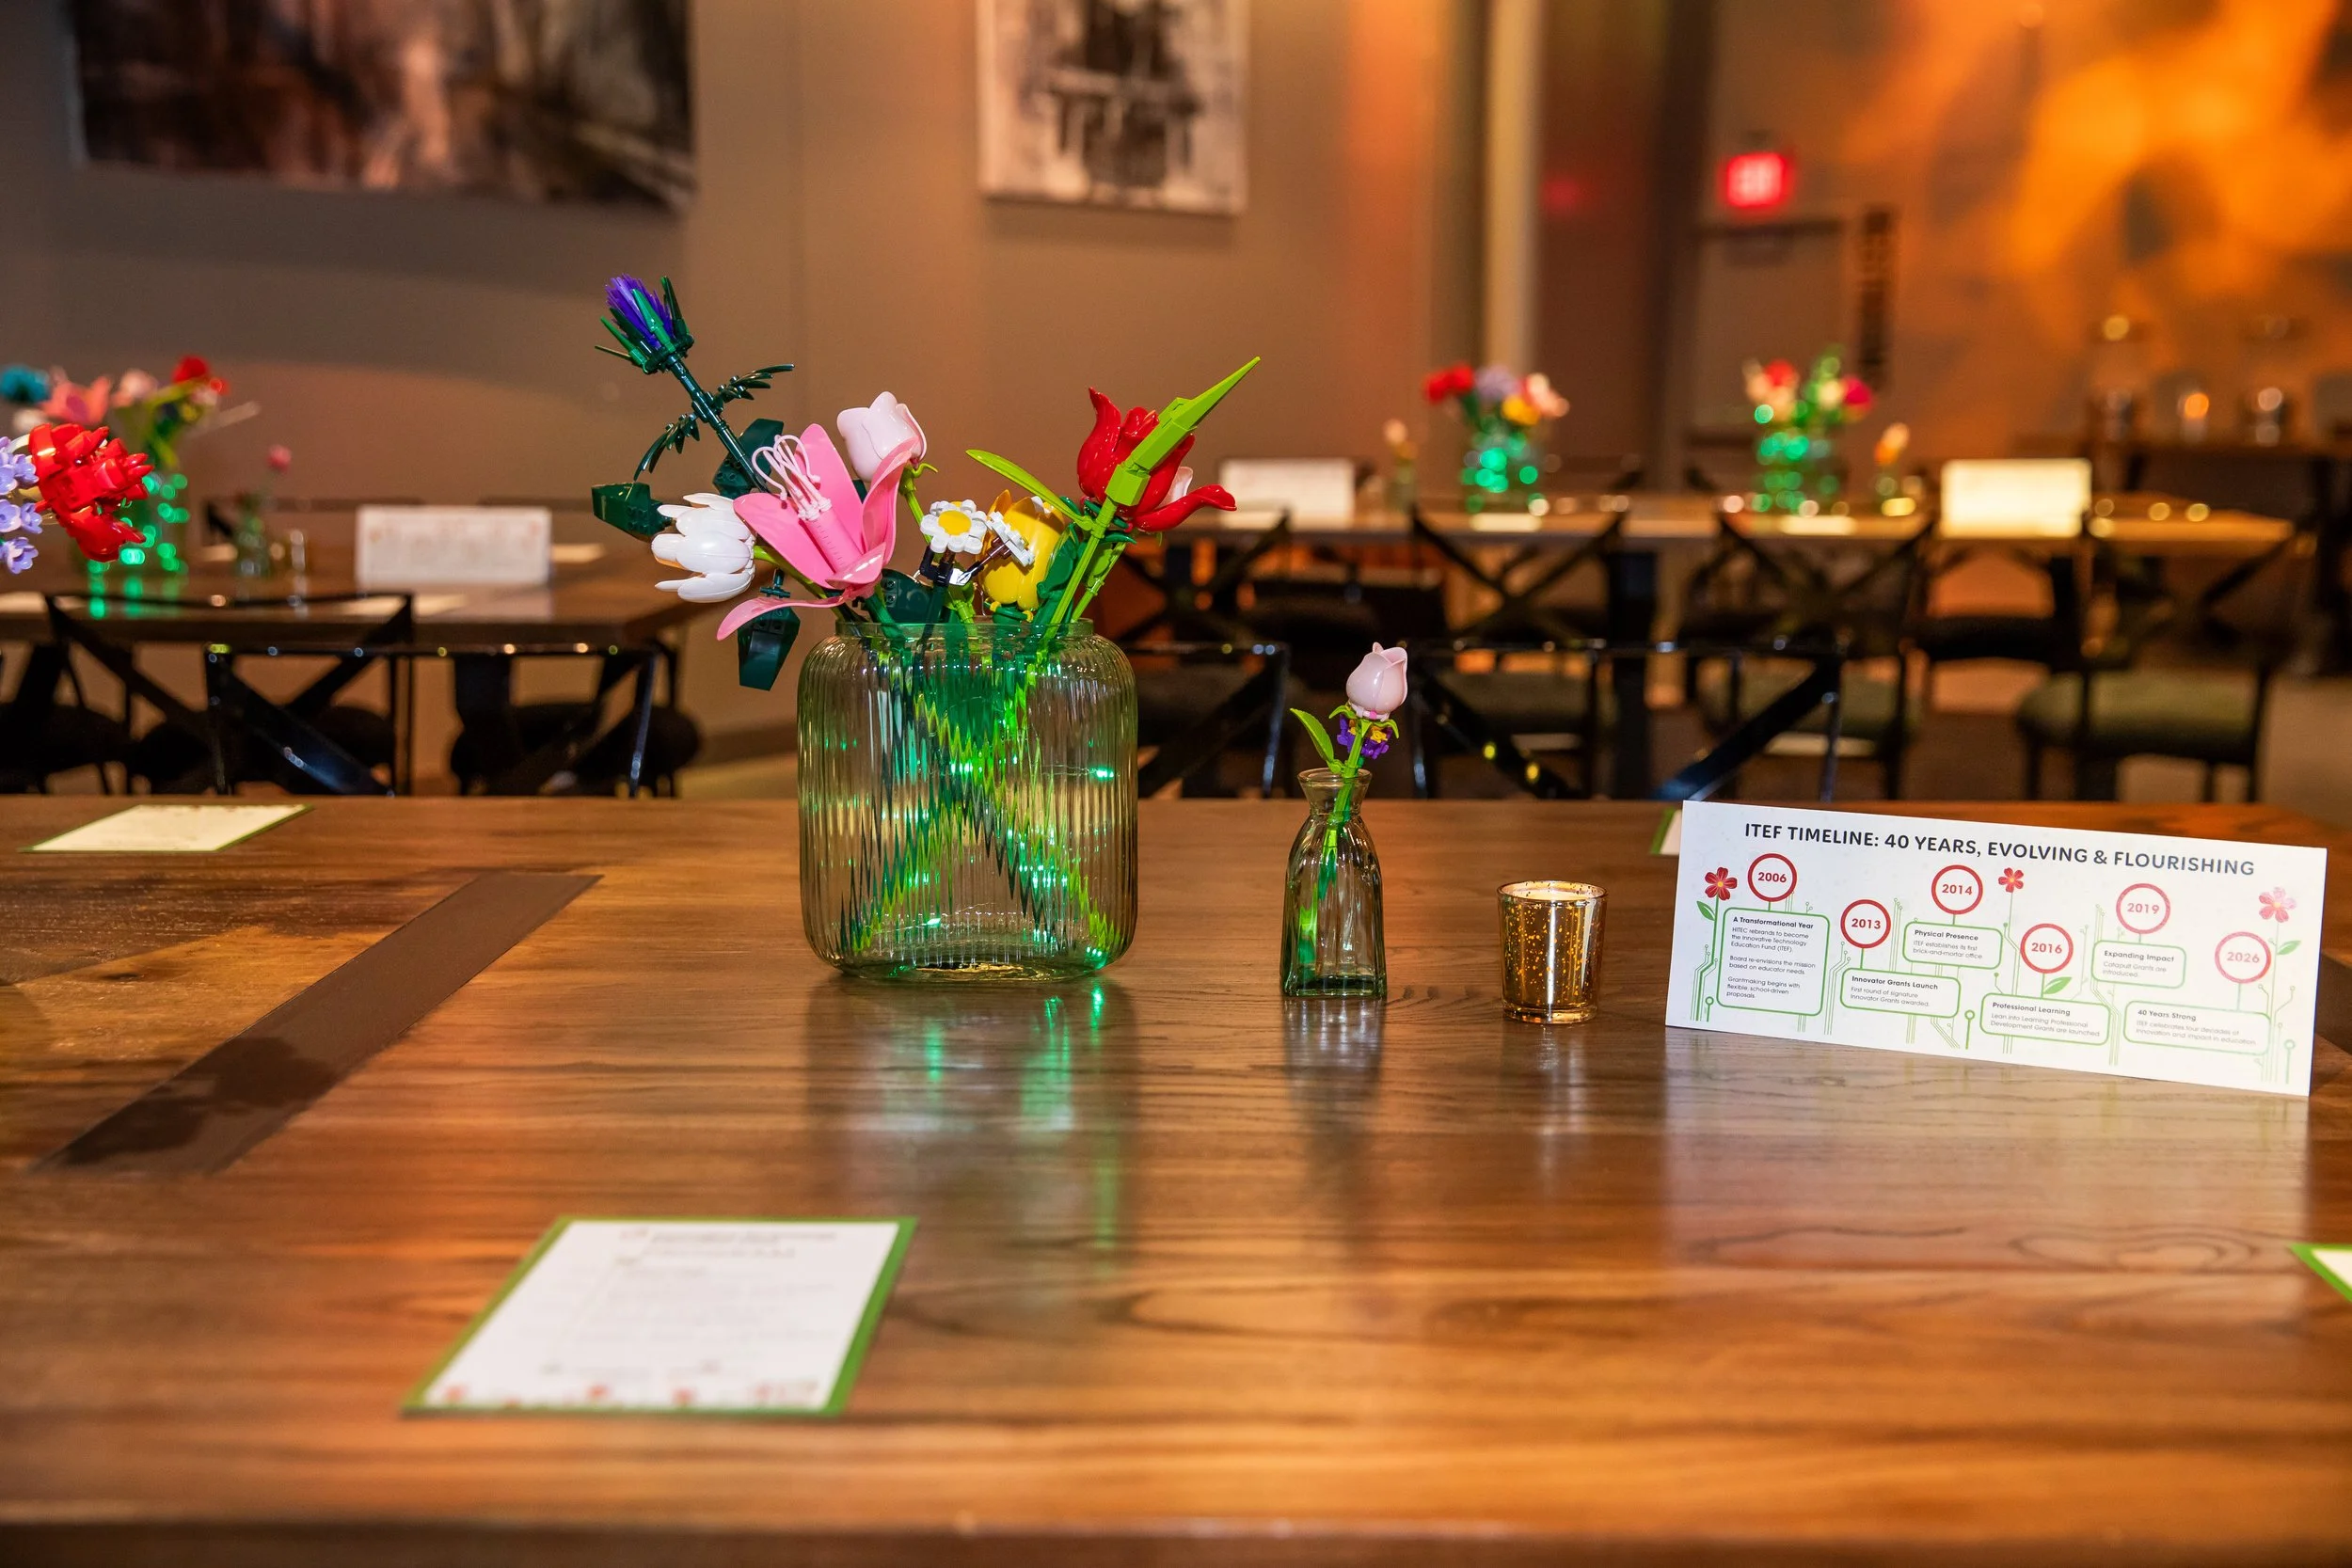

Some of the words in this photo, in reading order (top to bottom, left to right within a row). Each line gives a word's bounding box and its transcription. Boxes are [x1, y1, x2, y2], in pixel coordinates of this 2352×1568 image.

[1745, 823, 1782, 839] ITEF
[1788, 826, 1879, 847] TIMELINE:
[1884, 833, 1910, 848] 40
[1915, 835, 1981, 858] YEARS,
[1988, 841, 2088, 863] EVOLVING
[2093, 849, 2107, 864] &
[2114, 851, 2255, 876] FLOURISHING
[1757, 871, 1787, 884] 2006
[1942, 883, 1973, 896] 2014
[2127, 902, 2160, 915] 2019
[1740, 917, 1796, 927] Transformational
[1851, 918, 1881, 929] 2013
[1915, 929, 1944, 938] Physical
[1946, 932, 1979, 941] Presence
[1772, 938, 1806, 946] Technology
[1926, 942, 1958, 950] establishes
[1913, 948, 1963, 957] brick-and-mortar
[2031, 942, 2062, 954] 2016
[1748, 957, 1782, 965] re-envisions
[2104, 950, 2144, 961] Expanding
[2146, 954, 2174, 962] Impact
[2227, 951, 2260, 963] 2026
[1728, 976, 1766, 986] Grantmaking
[1851, 975, 1885, 985] Innovator
[1750, 986, 1788, 994] school-driven
[1890, 990, 1918, 999] signature
[1851, 993, 1879, 1002] Innovator
[1993, 1002, 2037, 1011] Professional
[2039, 1006, 2071, 1017] Learning
[2021, 1015, 2049, 1025] Learning
[2051, 1019, 2089, 1028] Professional
[2171, 1013, 2197, 1022] Strong
[1991, 1021, 2033, 1029] Development
[2150, 1022, 2184, 1030] celebrates
